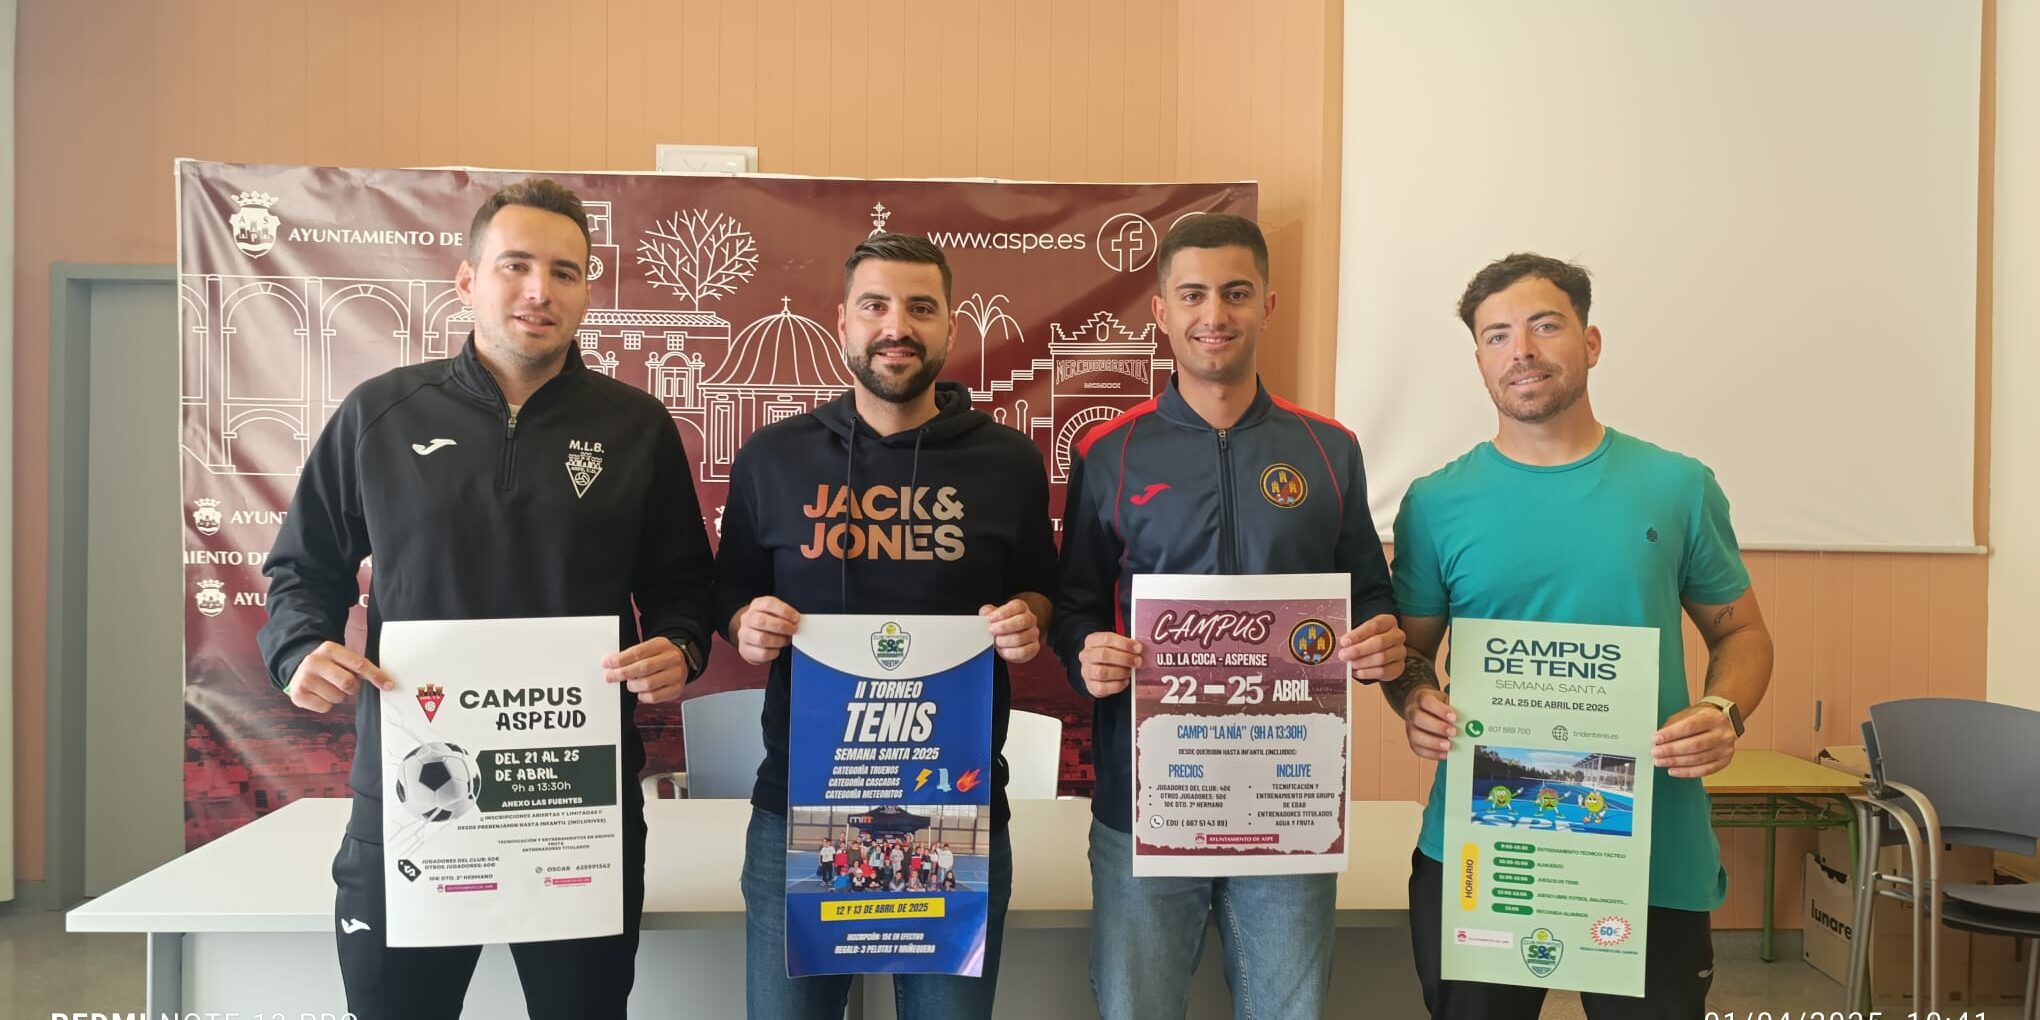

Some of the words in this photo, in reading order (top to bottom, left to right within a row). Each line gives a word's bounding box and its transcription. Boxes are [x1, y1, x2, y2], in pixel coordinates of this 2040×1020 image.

[288, 228, 434, 246] AYUNTAMIENTO
[440, 231, 464, 247] DE
[927, 232, 1086, 254] www.aspe.es
[803, 484, 965, 521] JACK&
[800, 522, 965, 562] JONES
[1153, 613, 1272, 646] CAMPUS
[1486, 637, 1621, 661] CAMPUS
[1156, 653, 1176, 666] U.D.
[1177, 653, 1190, 666] LA
[1191, 653, 1216, 666] COCA
[1224, 653, 1268, 666] ASPENSE
[1484, 656, 1524, 675] DE
[1530, 660, 1617, 681] TENIS
[855, 681, 867, 699] II
[869, 680, 923, 699] TORNEO
[1160, 675, 1197, 704] 22
[1227, 674, 1264, 704] 25
[1272, 679, 1313, 702] ABRIL
[1495, 679, 1555, 692] SEMANA
[1558, 683, 1607, 696] SANTA
[459, 686, 583, 710] CAMPUS
[1491, 697, 1503, 706] 22
[1504, 698, 1516, 707] AL
[1517, 699, 1530, 707] 25
[1530, 699, 1543, 708] DE
[1544, 701, 1571, 710] ABRIL
[1572, 702, 1585, 711] DE
[1586, 703, 1610, 712] 2025
[496, 709, 587, 731] ASPEUD
[843, 701, 937, 743] TENIS
[1177, 725, 1208, 739] CAMPO
[1250, 724, 1266, 742] (9H
[1267, 725, 1274, 740] A
[1275, 724, 1308, 742] 13:30H)
[495, 752, 520, 766] DEL
[525, 751, 538, 764] 21
[541, 750, 560, 763] AL
[563, 749, 580, 762] 25
[834, 748, 877, 760] SEMANA
[878, 747, 911, 760] SANTA
[911, 747, 940, 760] 2025
[495, 769, 512, 782] DE
[516, 767, 558, 781] ABRIL
[832, 764, 869, 775] CATEGORÍA
[870, 765, 900, 775] TRUENOS
[1168, 763, 1204, 779] PRECIOS
[1276, 763, 1312, 778] INCLUYE
[511, 783, 526, 793] 9h
[537, 781, 572, 792] 13:30h
[828, 776, 865, 787] CATEGORÍA
[865, 777, 901, 787] CASCADAS
[825, 788, 861, 799] CATEGORÍA
[862, 789, 904, 799] METEORITOS
[502, 800, 531, 808] ANEXO
[531, 799, 547, 807] LAS
[548, 797, 583, 806] FUENTES
[1465, 859, 1474, 898] HORARIO
[836, 906, 845, 915] 12
[847, 906, 853, 914] Y
[854, 905, 862, 914] 13
[864, 904, 873, 914] DE
[875, 904, 896, 913] ABRIL
[897, 903, 908, 912] DE
[908, 902, 929, 912] 2025
